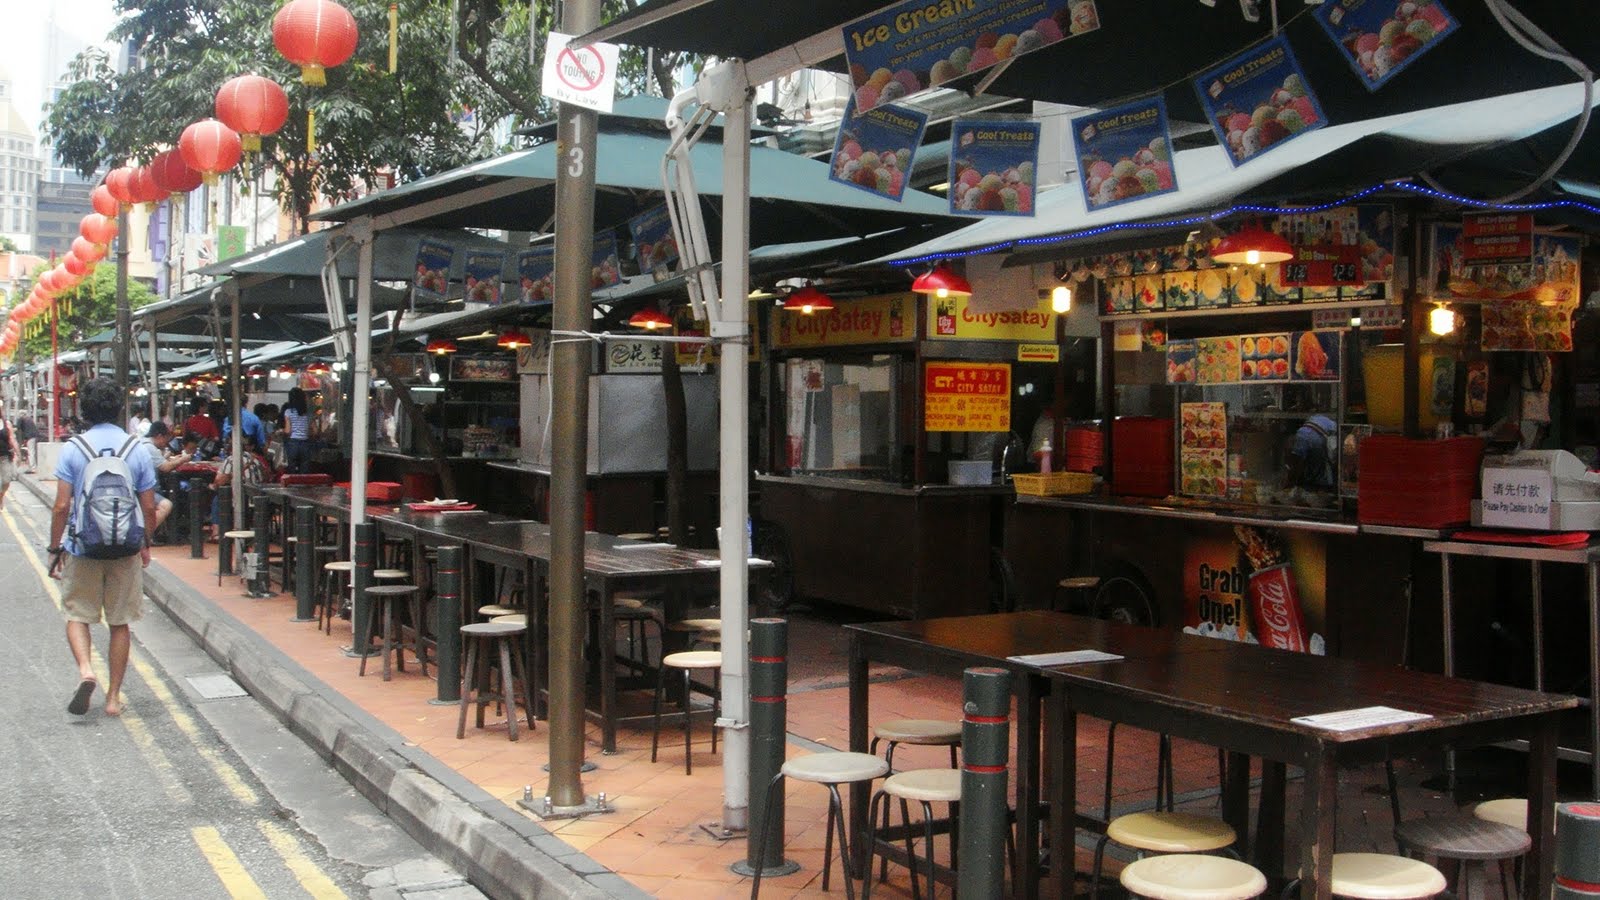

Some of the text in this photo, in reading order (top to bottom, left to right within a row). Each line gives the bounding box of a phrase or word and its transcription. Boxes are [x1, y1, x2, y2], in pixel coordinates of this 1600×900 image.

[851, 24, 891, 52] Ice
[1223, 66, 1246, 83] Cool
[1246, 47, 1284, 71] Treats
[1098, 116, 1119, 130] Cool
[1120, 108, 1158, 124] Treats
[977, 131, 1034, 140] Cool Treats
[957, 383, 1001, 393] CITY SATAY
[1493, 482, 1540, 498] 请先付款
[1483, 501, 1499, 511] Please
[1500, 502, 1509, 514] Pay
[1200, 563, 1242, 594] Grab
[1200, 594, 1240, 626] One!
